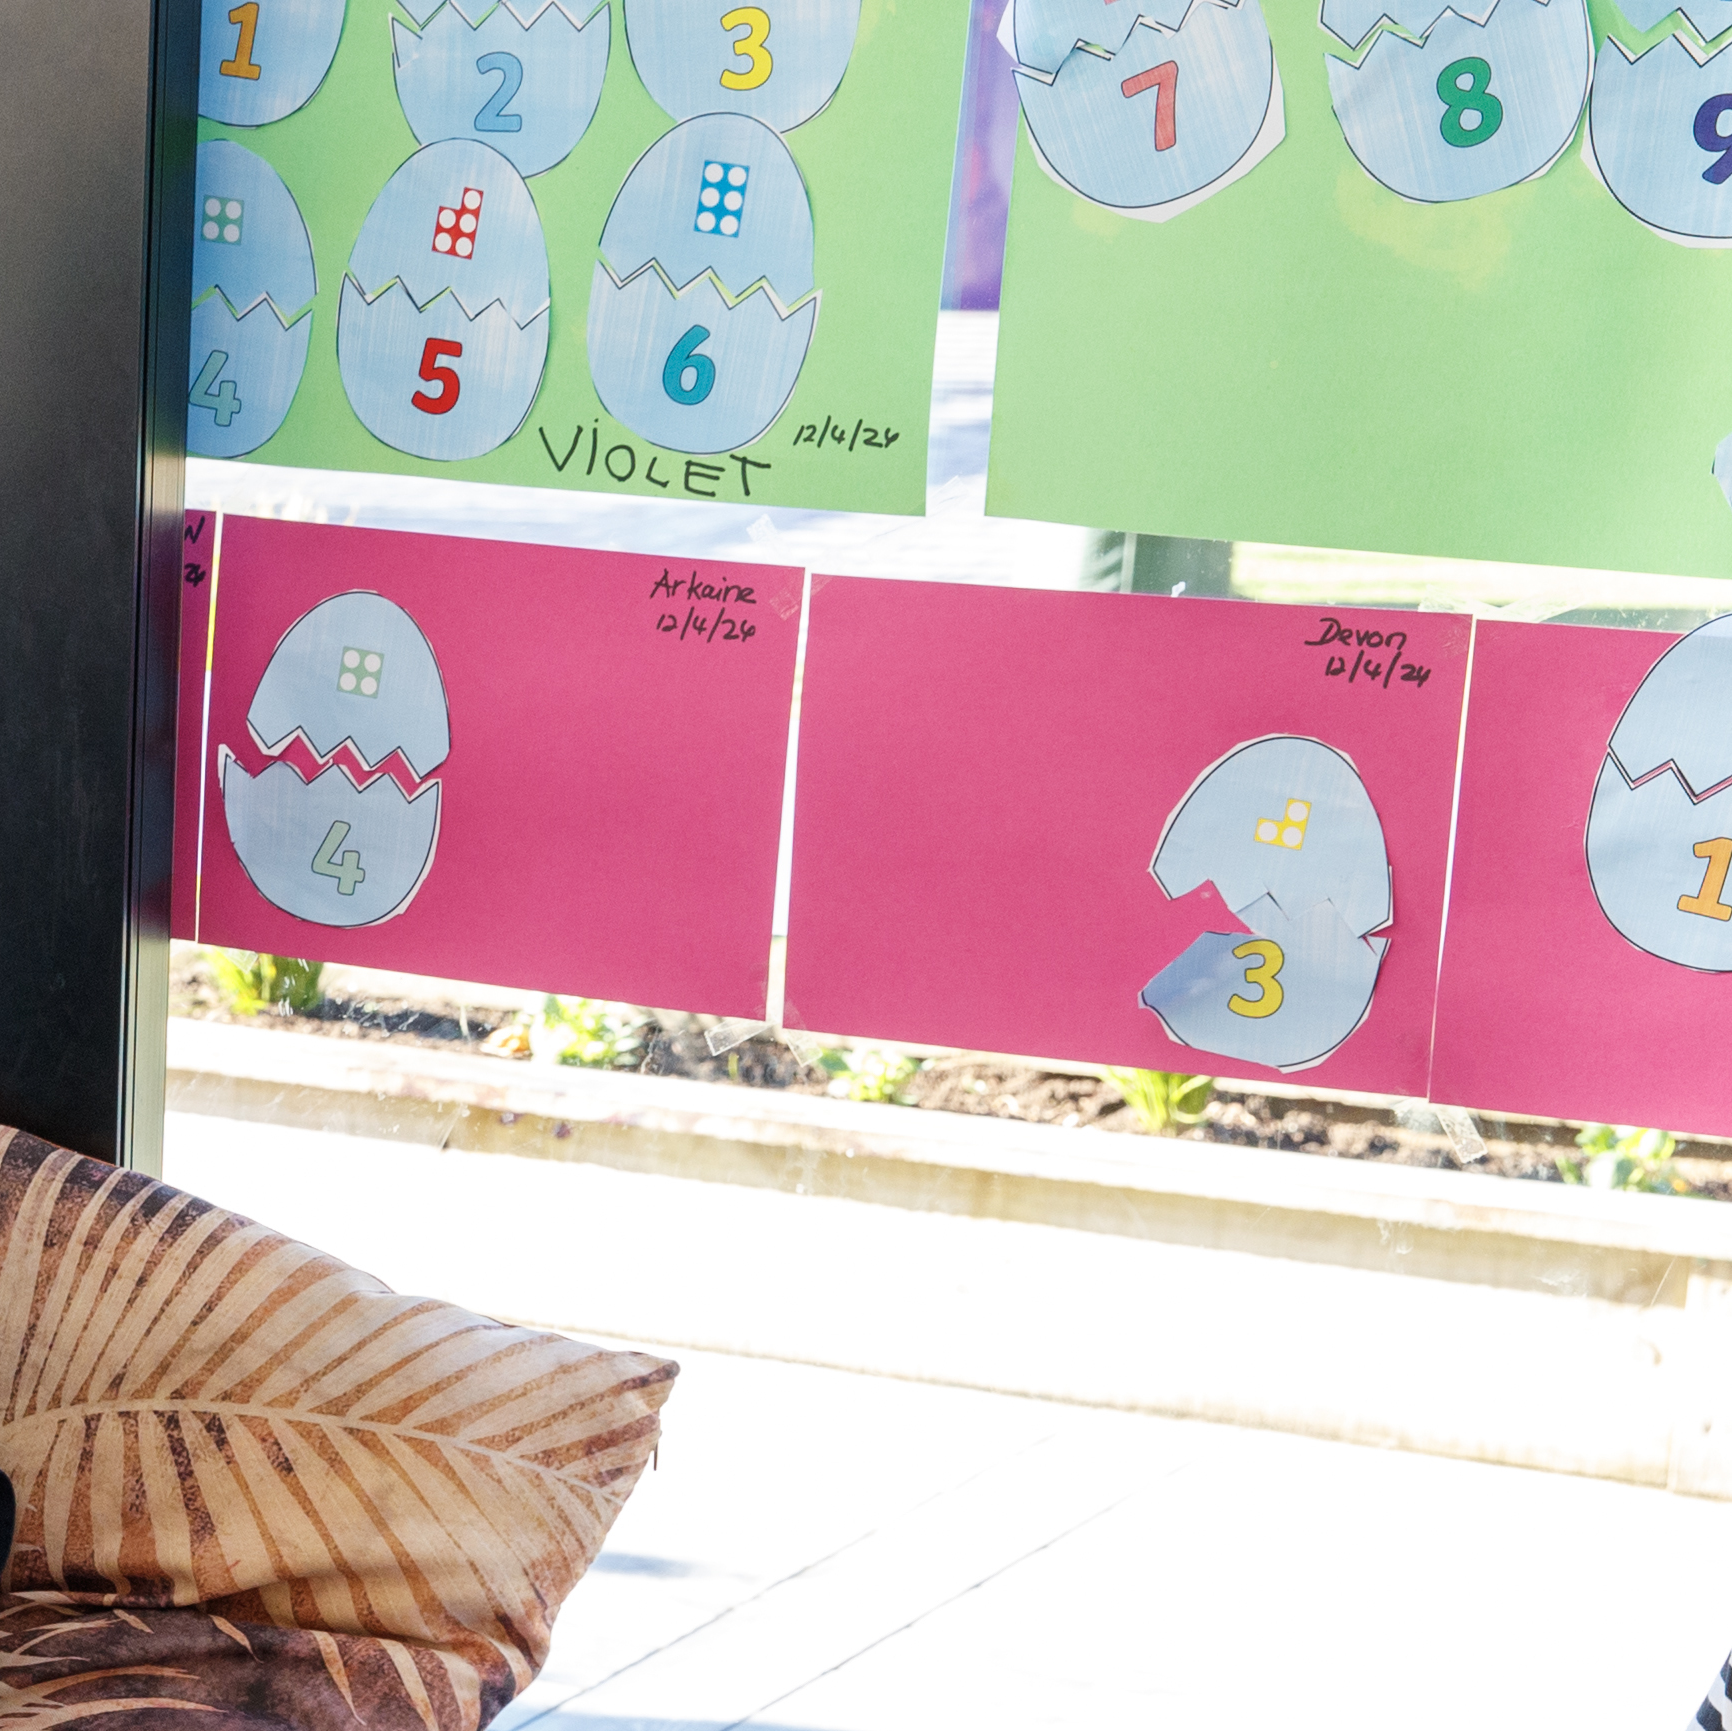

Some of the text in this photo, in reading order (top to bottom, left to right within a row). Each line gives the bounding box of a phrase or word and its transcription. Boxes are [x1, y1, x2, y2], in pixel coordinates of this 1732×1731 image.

[719, 6, 774, 91] 3
[473, 51, 523, 133] 2
[1120, 60, 1178, 152] 7
[1435, 56, 1504, 148] 8
[411, 337, 463, 415] 5
[662, 324, 717, 405] 6
[649, 567, 758, 605] Arkaine
[1303, 617, 1408, 651] Devon
[310, 820, 366, 896] 4
[1227, 938, 1286, 1019] 3
